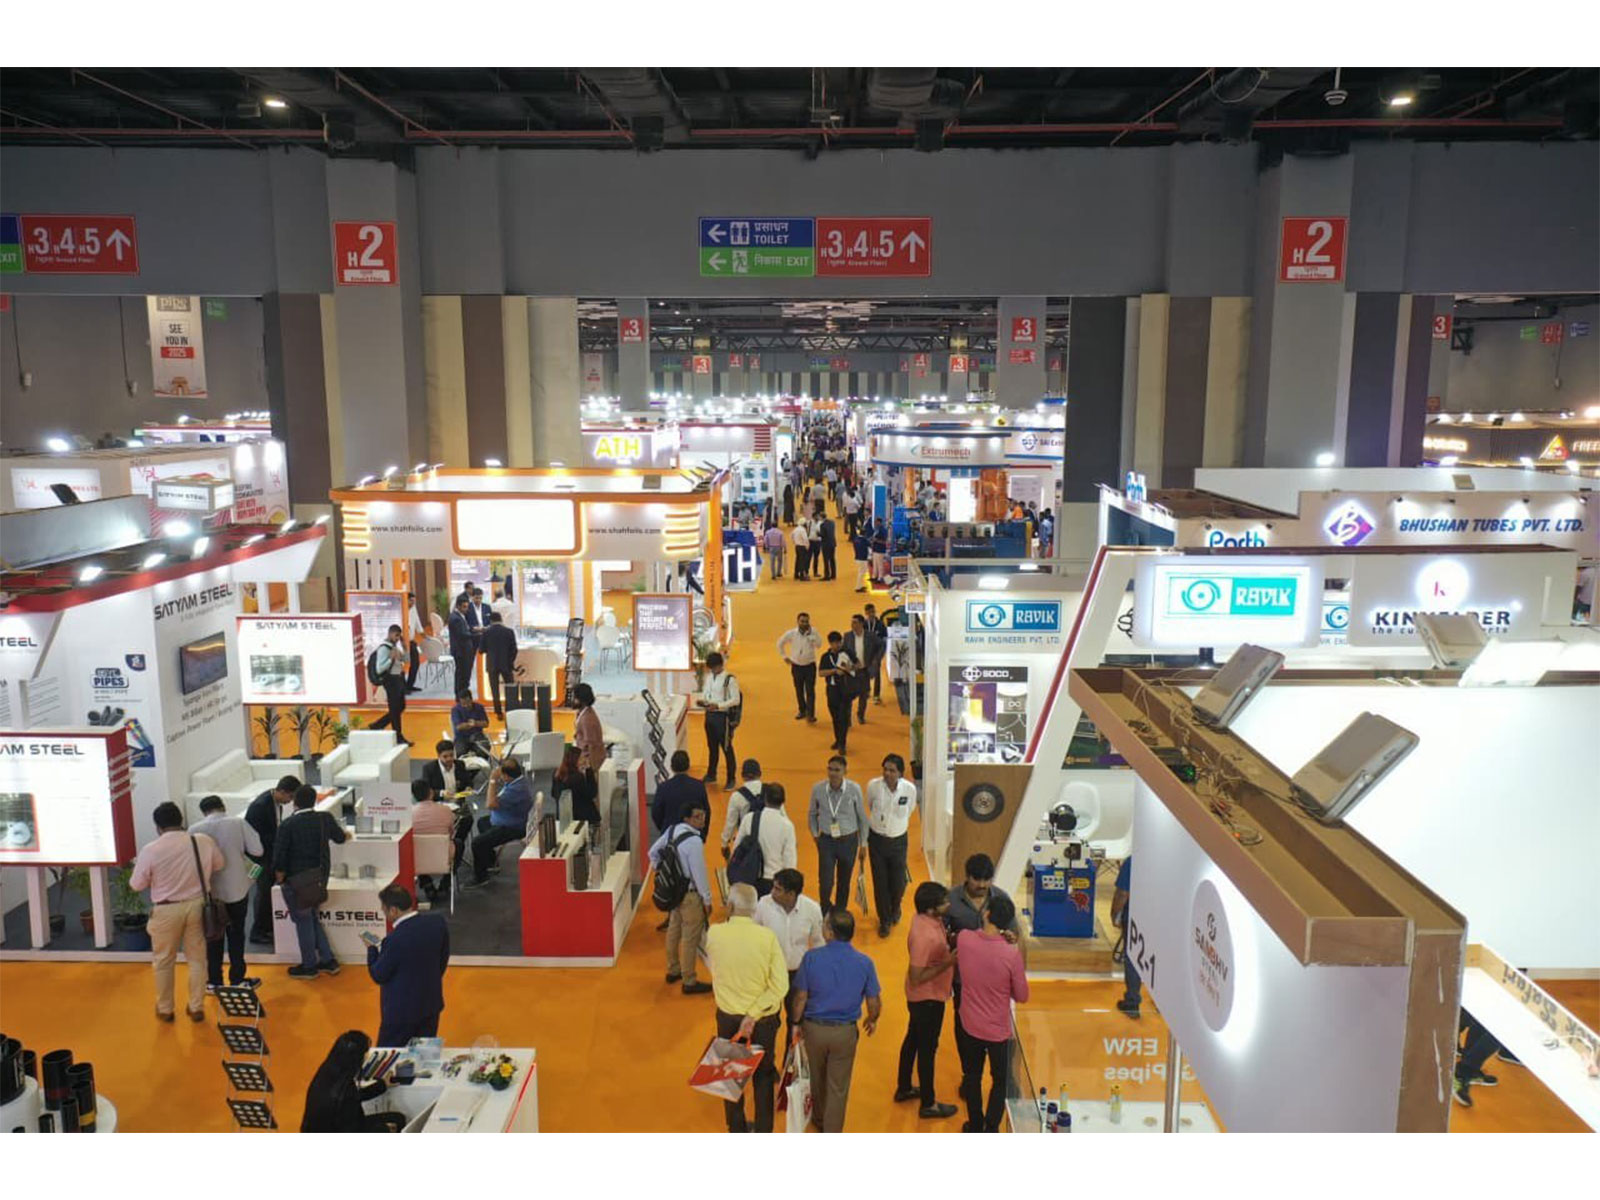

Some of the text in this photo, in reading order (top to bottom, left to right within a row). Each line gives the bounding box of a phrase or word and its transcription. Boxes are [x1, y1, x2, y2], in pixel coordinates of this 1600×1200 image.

[754, 235, 789, 244] TOILET
[0, 252, 16, 263] XIT
[787, 256, 809, 266] EXIT
[169, 324, 184, 333] SEE
[166, 336, 188, 345] YOU IN
[595, 438, 642, 458] ATH
[1399, 519, 1585, 532] BHUSHAN TUBES PVT. LTD.
[154, 588, 198, 620] SATYAM
[200, 583, 234, 605] STEEL
[1236, 587, 1292, 607] RAVIK
[1015, 610, 1055, 623] RAVIK
[256, 622, 337, 630] SATYAM STEEL
[1372, 626, 1392, 634] the
[93, 677, 125, 686] PIPES
[30, 744, 86, 755] STEEL
[335, 910, 384, 921] STEEL
